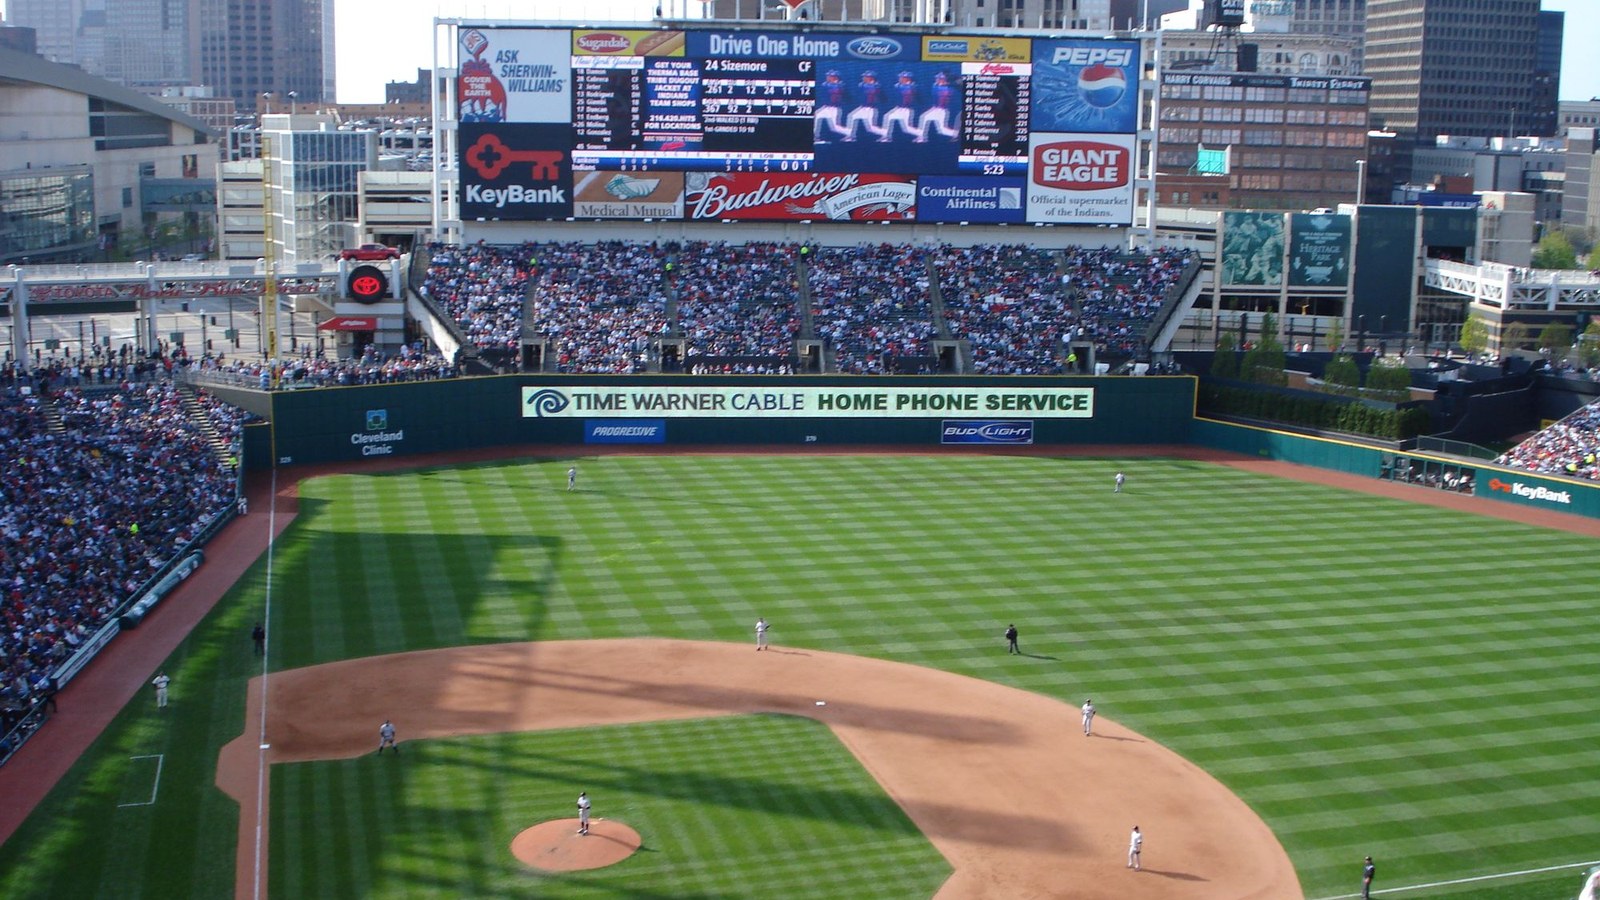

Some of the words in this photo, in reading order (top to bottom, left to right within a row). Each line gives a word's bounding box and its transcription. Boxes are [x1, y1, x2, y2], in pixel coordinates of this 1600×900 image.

[578, 37, 629, 50] Sugardale
[710, 34, 752, 55] Drive
[757, 35, 788, 56] One
[793, 36, 839, 57] Home
[857, 40, 891, 55] Ford
[496, 50, 519, 63] ASK
[1051, 47, 1133, 66] PEPSI
[501, 65, 557, 78] SHERWIN-
[705, 60, 718, 70] 24
[721, 60, 767, 71] Sizemore
[798, 61, 811, 72] CF
[980, 63, 1014, 75] Indians
[1164, 75, 1191, 84] HARRY
[508, 80, 563, 92] WILLIAMS
[705, 86, 722, 94] .261
[746, 86, 756, 94] 12
[764, 87, 775, 95] 24
[783, 87, 792, 95] 11
[800, 87, 811, 95] 12
[727, 105, 738, 113] 92
[783, 106, 789, 114] 7
[794, 106, 812, 114] .370
[1042, 148, 1121, 165] GIANT
[781, 161, 788, 170] 0
[792, 161, 798, 170] 0
[803, 161, 808, 170] 1
[984, 164, 1004, 175] 5:23
[1043, 166, 1119, 182] EAGLE
[466, 185, 565, 208] KeyBank
[686, 173, 859, 219] Budweiser
[921, 186, 996, 198] Continental
[833, 190, 880, 211] American
[882, 188, 913, 200] Lager
[946, 199, 996, 209] Airlines
[1031, 194, 1066, 205] Official
[1069, 195, 1128, 207] supermarket
[581, 205, 628, 217] Medical
[633, 205, 676, 217] Mutual
[1045, 207, 1055, 216] of
[1058, 207, 1072, 216] the
[1075, 208, 1113, 217] Indians.
[55, 287, 113, 297] TOYOTA
[572, 394, 627, 410] TIME
[632, 394, 726, 410] WARNER
[732, 394, 804, 410] CABLE
[818, 394, 887, 410] HOME
[896, 394, 978, 410] PHONE
[985, 394, 1088, 410] SERVICE
[351, 430, 403, 444] Cleveland
[593, 426, 657, 436] PROGRESSIVE
[944, 427, 978, 436] BUD
[985, 427, 1030, 436] LIGHT
[362, 444, 392, 455] Clinic
[1512, 482, 1571, 503] KeyBank
